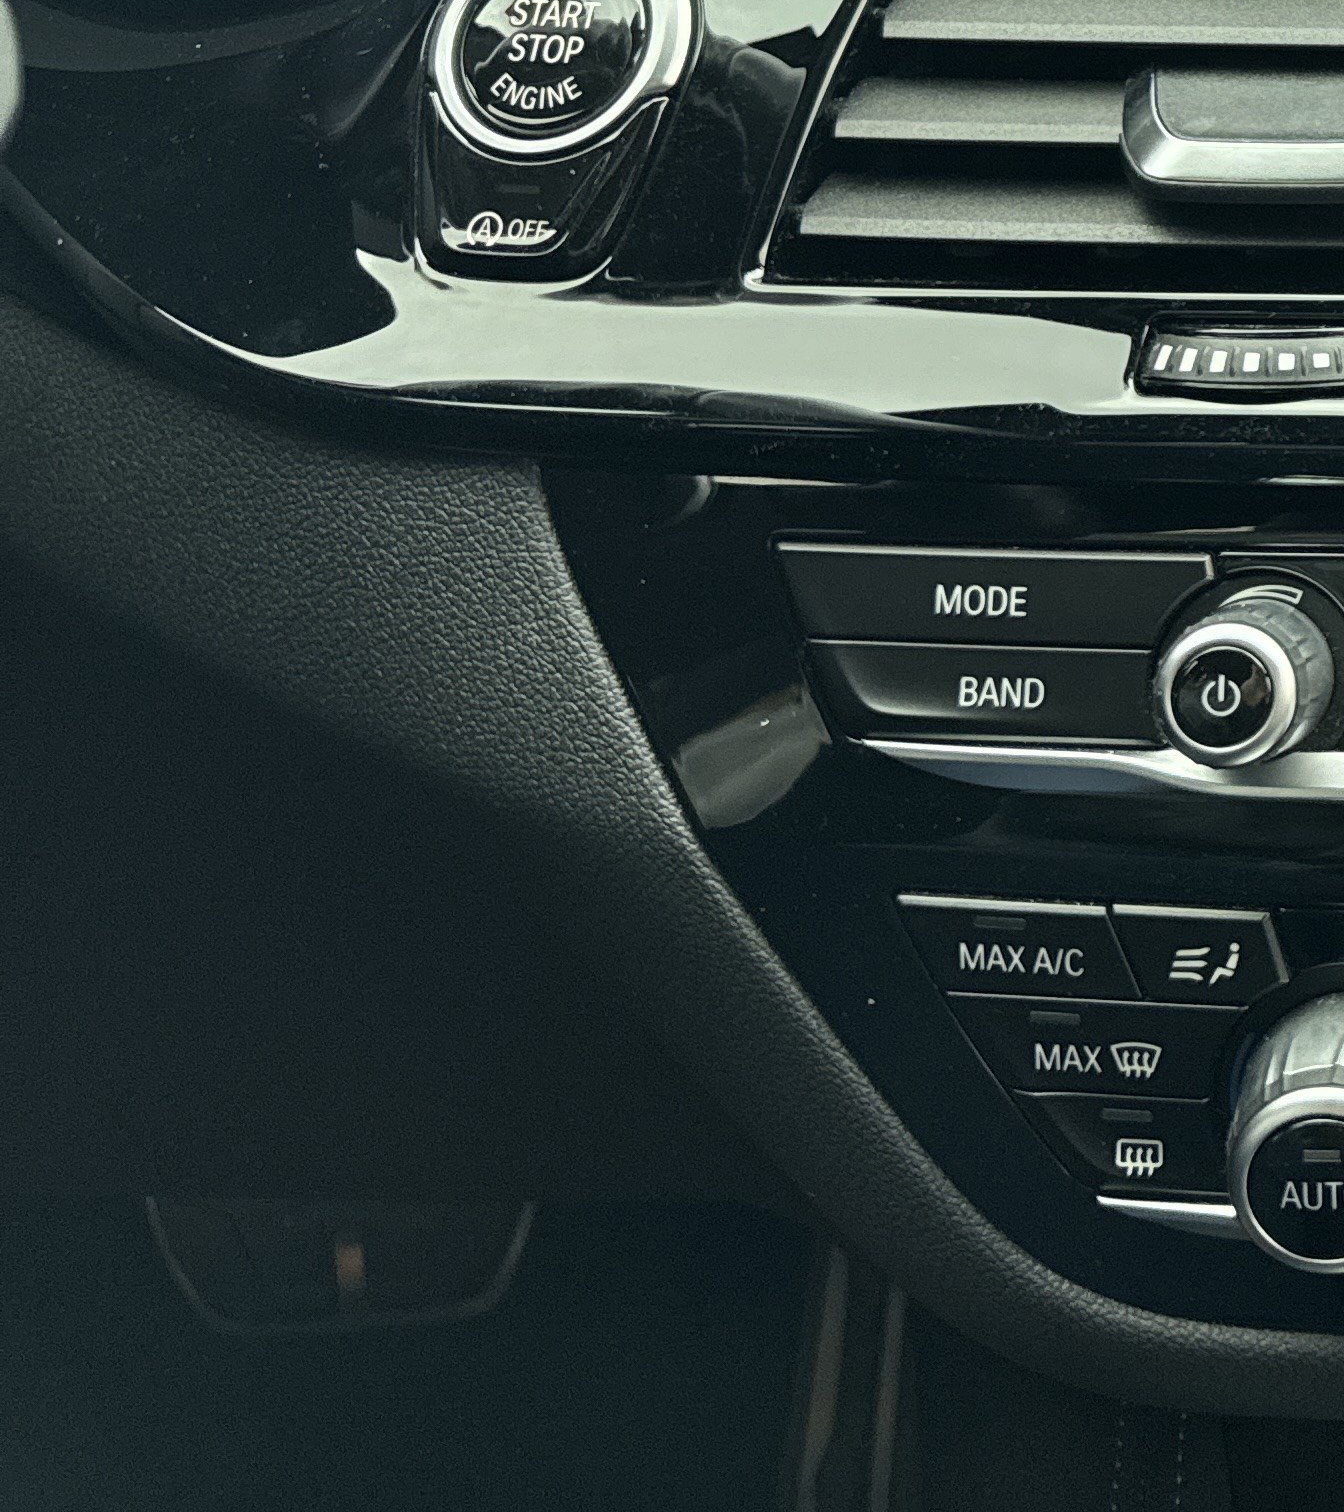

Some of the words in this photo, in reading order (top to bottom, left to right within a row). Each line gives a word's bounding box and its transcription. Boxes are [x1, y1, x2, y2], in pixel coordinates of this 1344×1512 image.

[508, 34, 584, 64] STOP
[490, 72, 583, 110] ENGINE
[508, 218, 549, 240] OFF
[934, 585, 1027, 617] MODE
[958, 677, 1045, 708] BAND
[959, 943, 1026, 973] MAX
[1033, 946, 1085, 976] A/C
[1034, 1044, 1102, 1074] MAX
